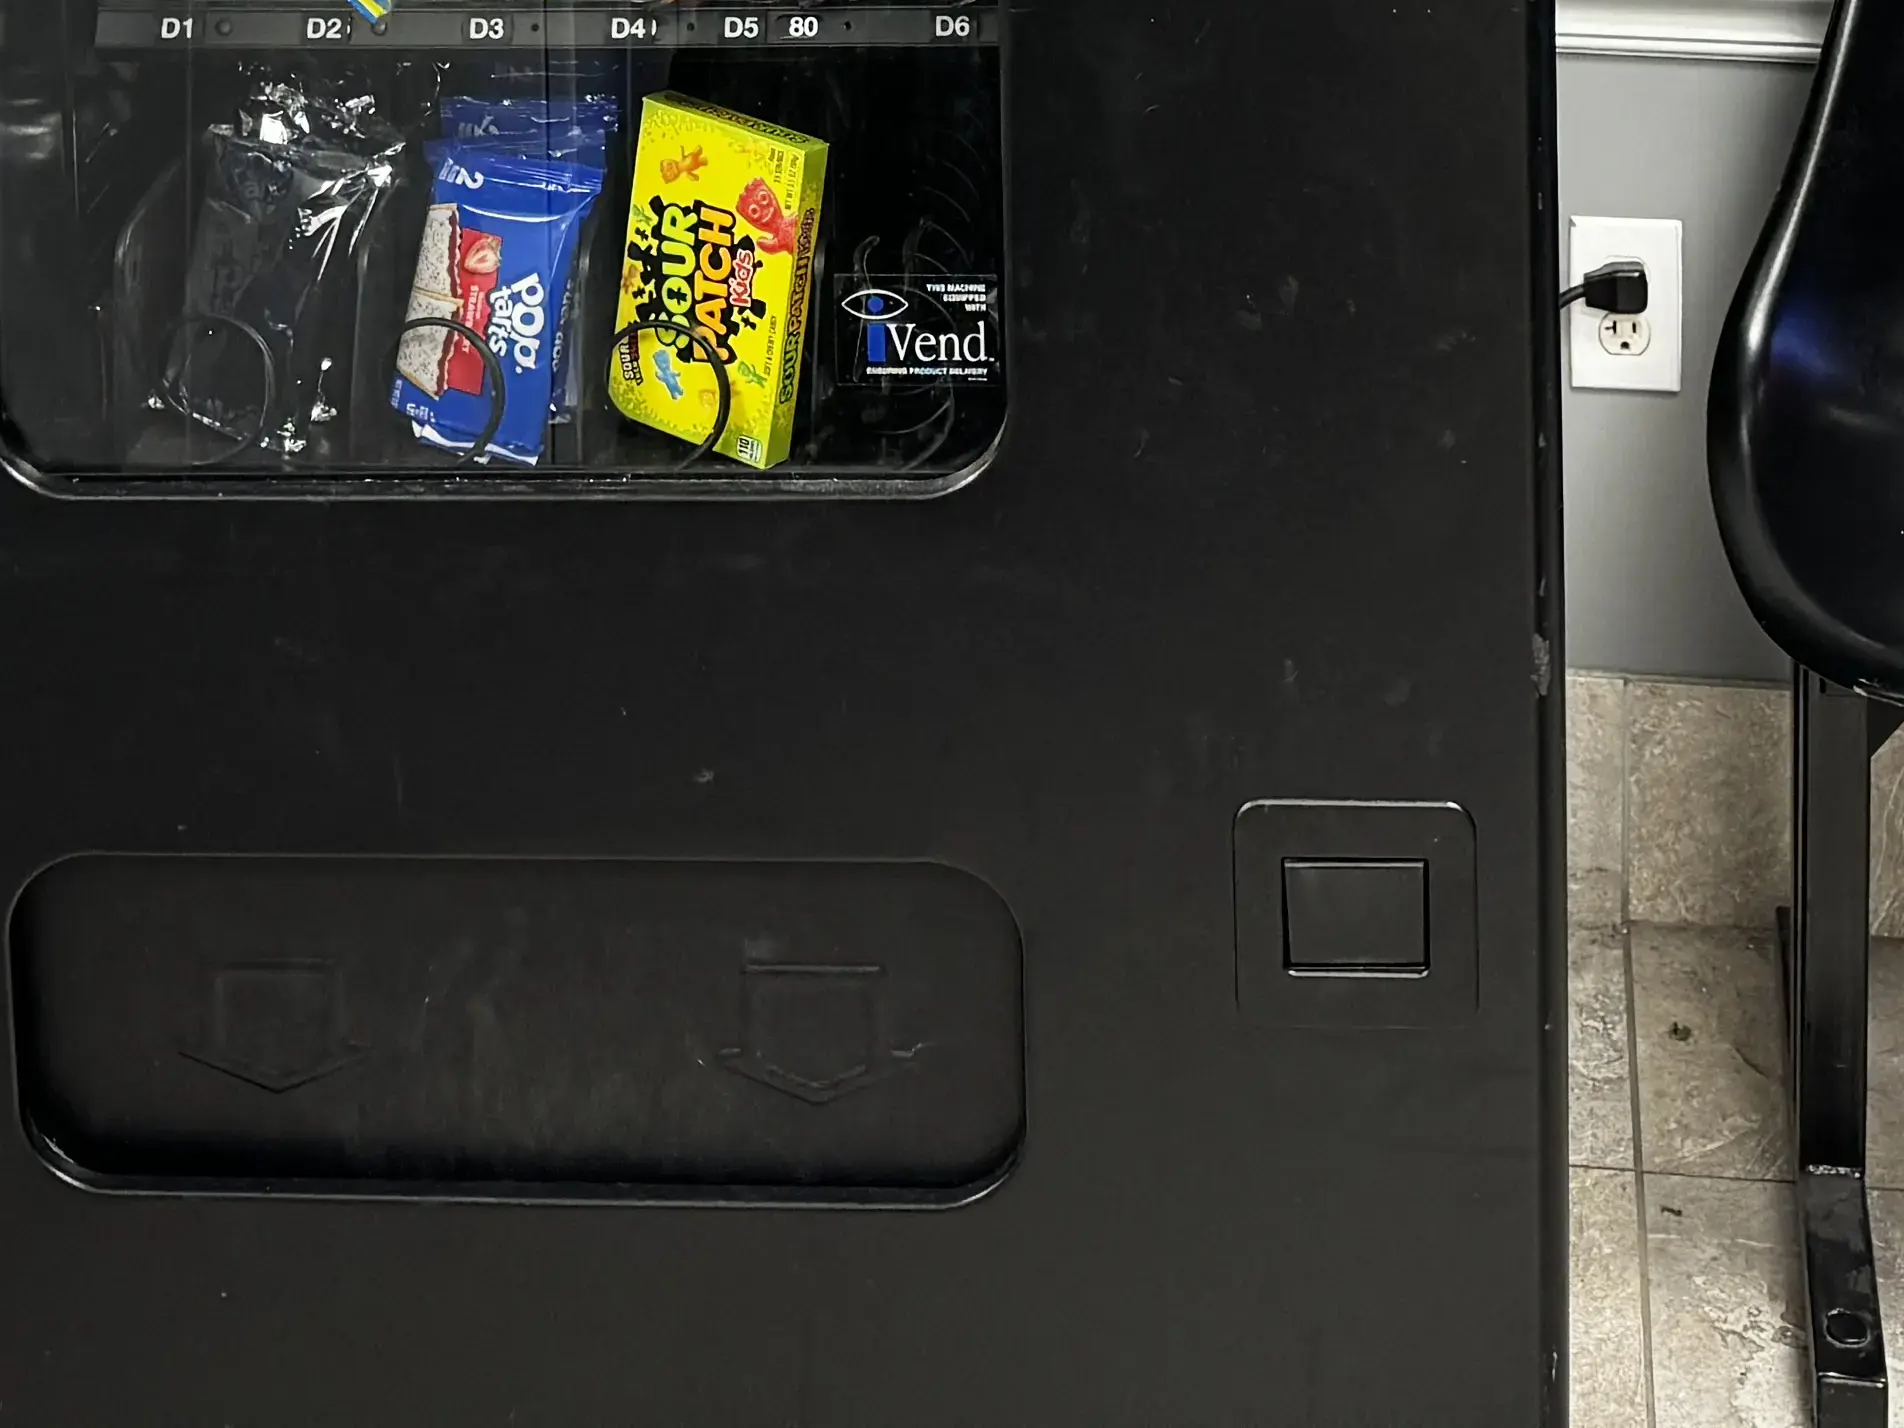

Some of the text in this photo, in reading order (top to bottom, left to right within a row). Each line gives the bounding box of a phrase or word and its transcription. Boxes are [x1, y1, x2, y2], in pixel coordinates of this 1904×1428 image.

[162, 17, 194, 38] D1
[306, 17, 342, 38] D2
[469, 17, 505, 38] D3
[610, 17, 646, 39] D4
[724, 17, 759, 38] D5
[789, 16, 819, 37] 80
[935, 16, 971, 37] D6
[459, 170, 485, 190] 2
[657, 205, 698, 351] SOUR
[692, 203, 737, 364] PATCH
[728, 248, 755, 309] Kids
[947, 283, 986, 292] MACHINE
[943, 293, 987, 302] EQUIPPED
[965, 303, 987, 312] WITH
[489, 285, 512, 358] tarts
[780, 256, 810, 405] SOUR PATCH
[623, 334, 636, 380] SOUR
[909, 366, 948, 375] PRODUCT
[949, 367, 988, 376] DELIVERY
